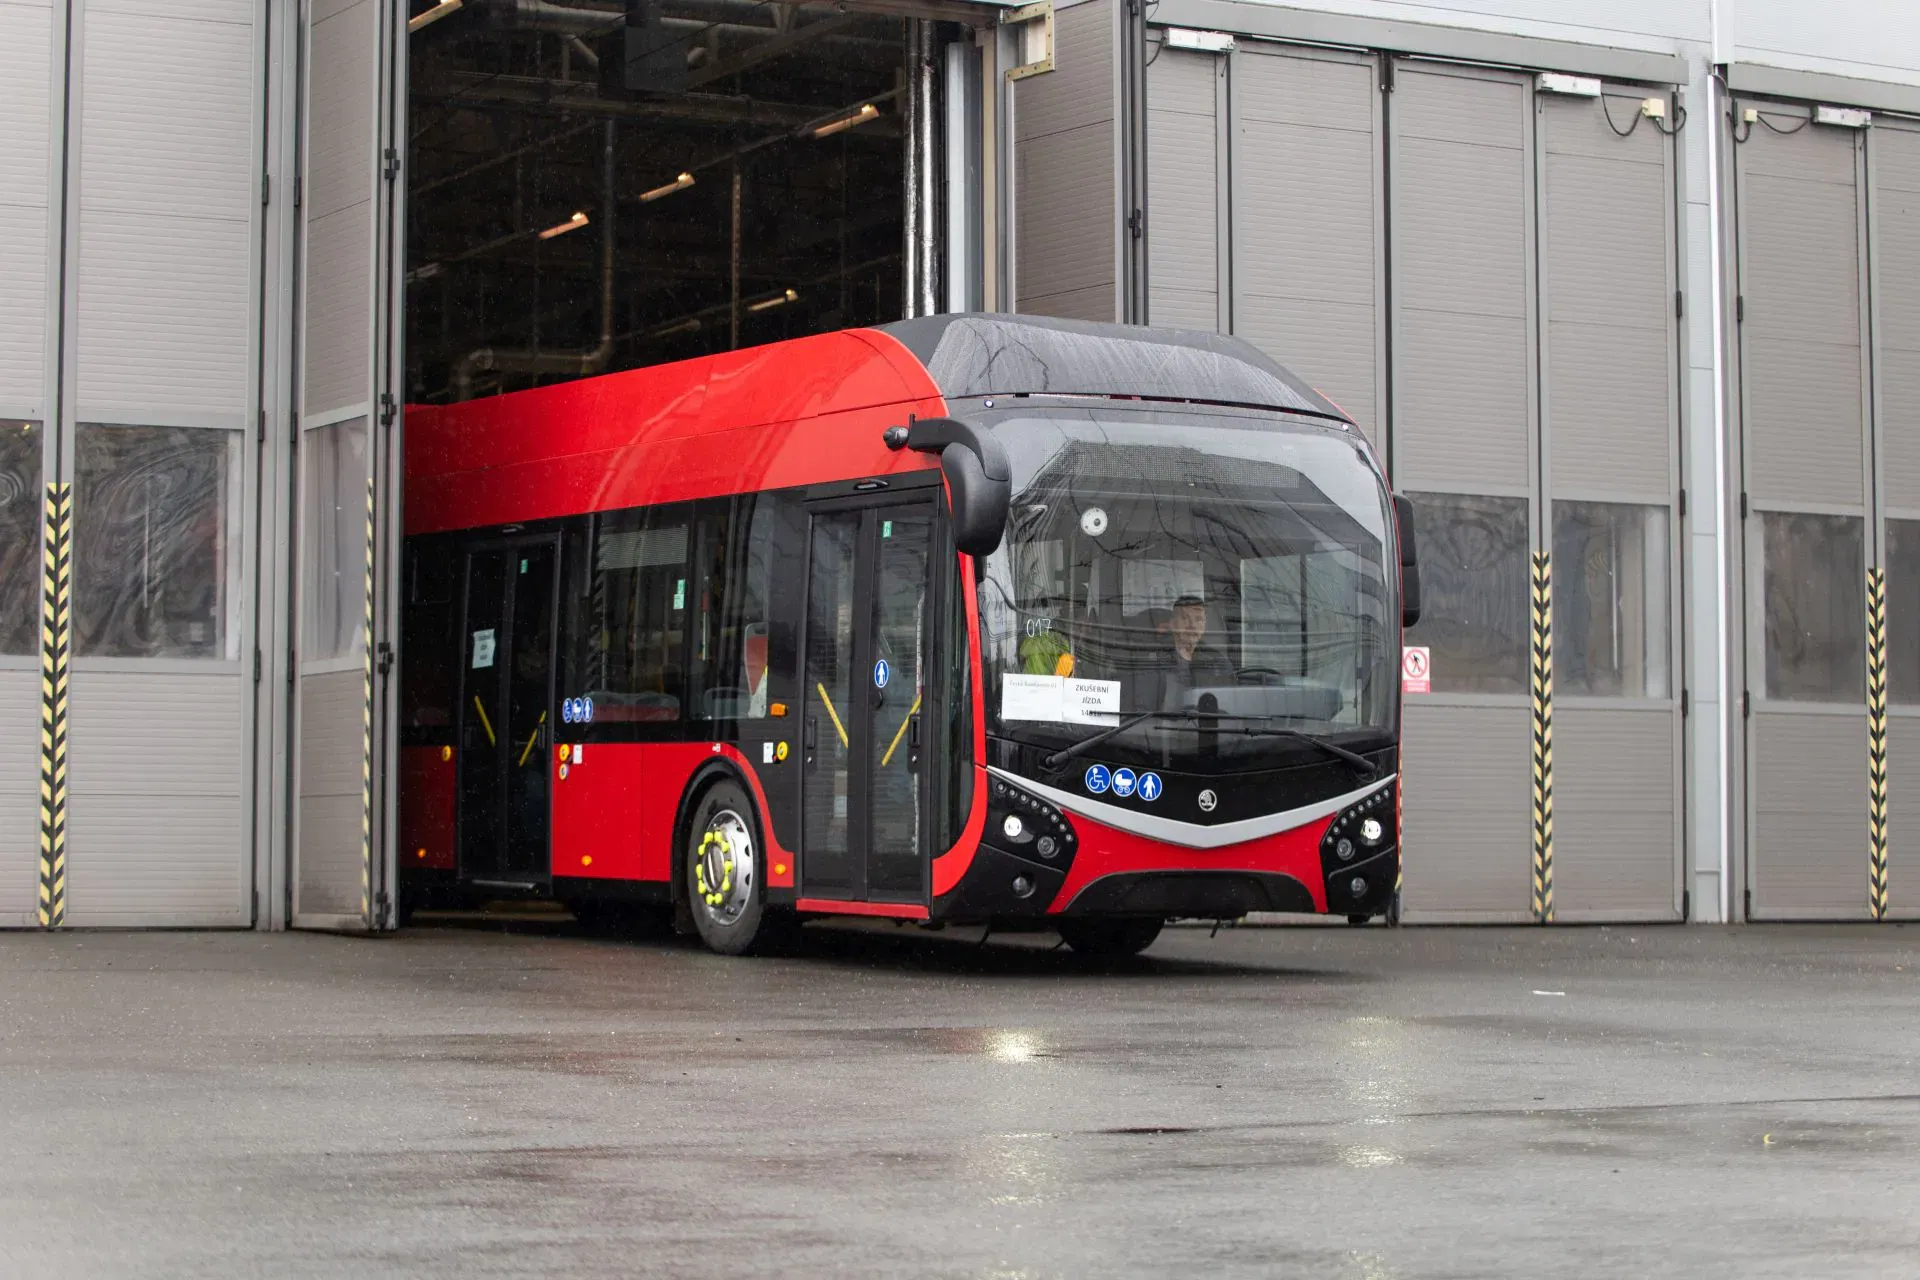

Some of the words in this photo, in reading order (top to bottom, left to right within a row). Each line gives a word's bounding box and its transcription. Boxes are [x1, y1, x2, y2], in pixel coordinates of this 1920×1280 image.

[1027, 618, 1052, 638] 017
[1075, 684, 1109, 694] ZKUŠEBNÍ
[1082, 696, 1101, 705] JÍZDA
